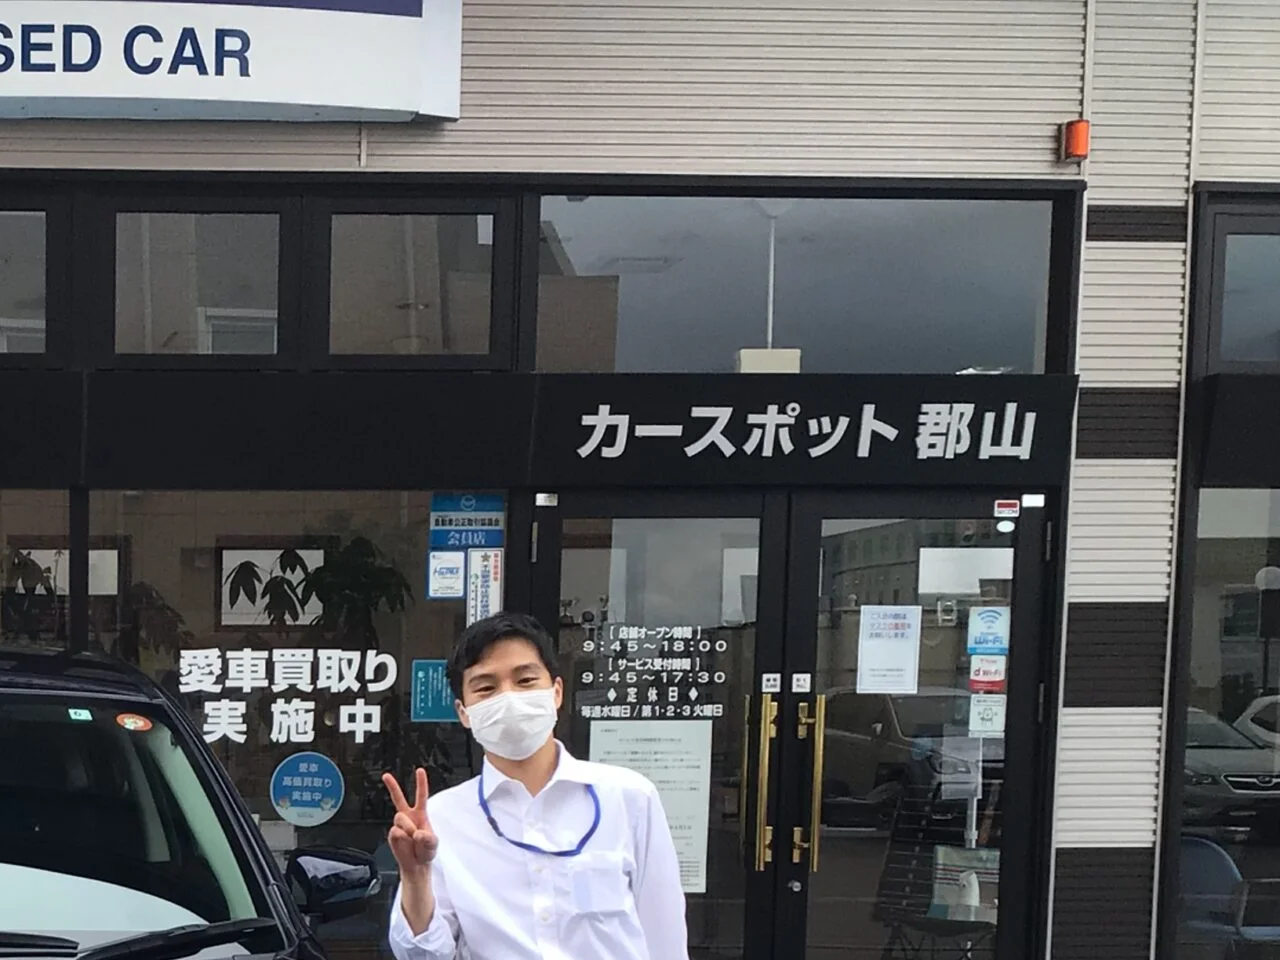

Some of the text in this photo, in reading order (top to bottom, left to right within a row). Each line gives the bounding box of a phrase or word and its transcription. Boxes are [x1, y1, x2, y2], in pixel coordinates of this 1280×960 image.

[123, 25, 251, 77] CAR
[577, 402, 1037, 460] カースポット 郡山
[178, 647, 398, 693] 愛車買取り
